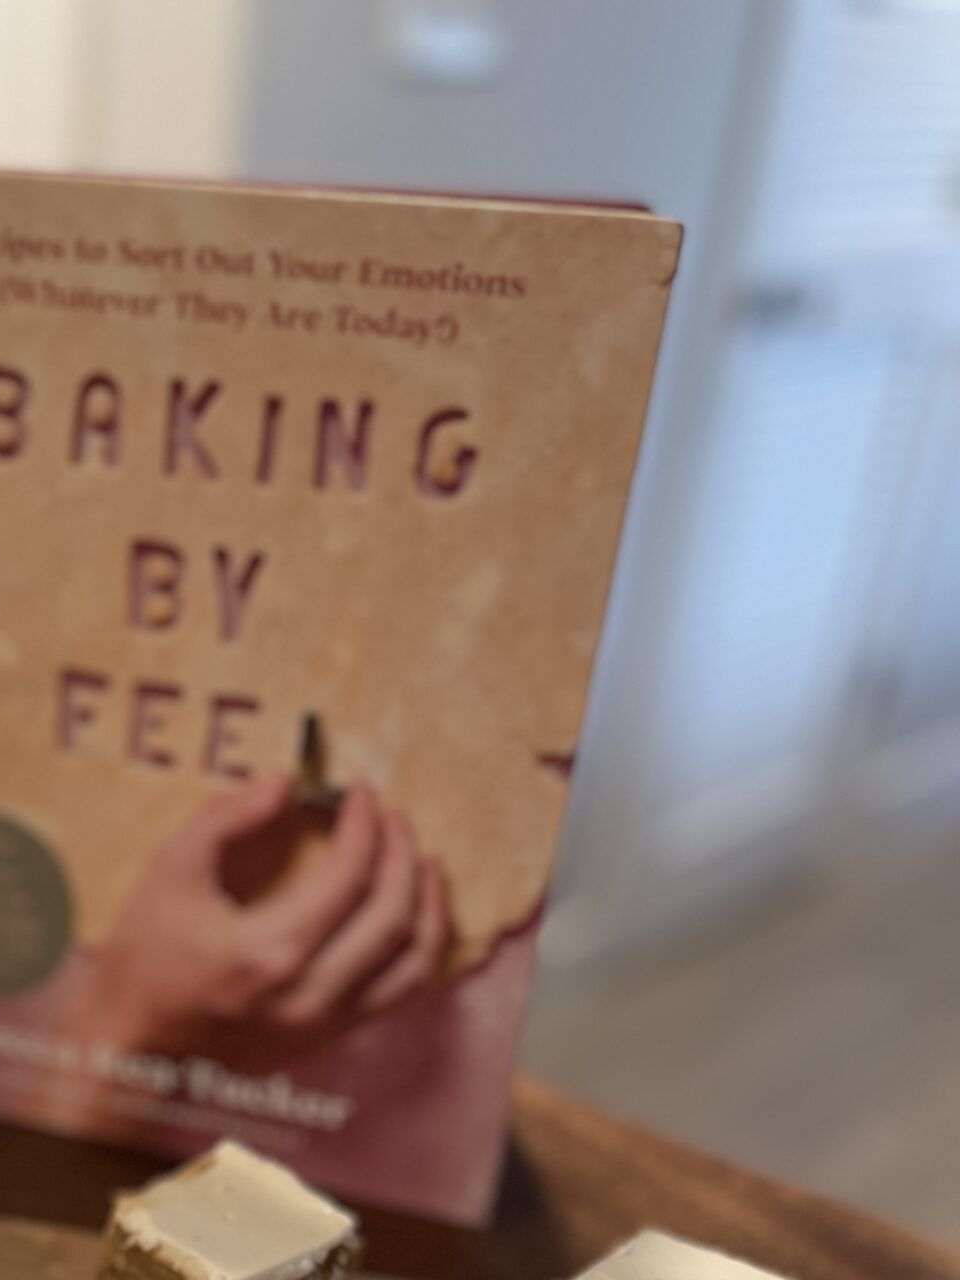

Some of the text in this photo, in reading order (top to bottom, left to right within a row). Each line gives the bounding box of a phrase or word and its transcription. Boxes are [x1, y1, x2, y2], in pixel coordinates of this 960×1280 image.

[73, 238, 107, 263] to
[117, 237, 184, 271] Sort
[194, 245, 255, 277] Out
[270, 250, 346, 282] Your
[359, 256, 526, 298] Emotions
[175, 290, 247, 333] They
[269, 302, 320, 334] Are
[128, 535, 266, 645] BY
